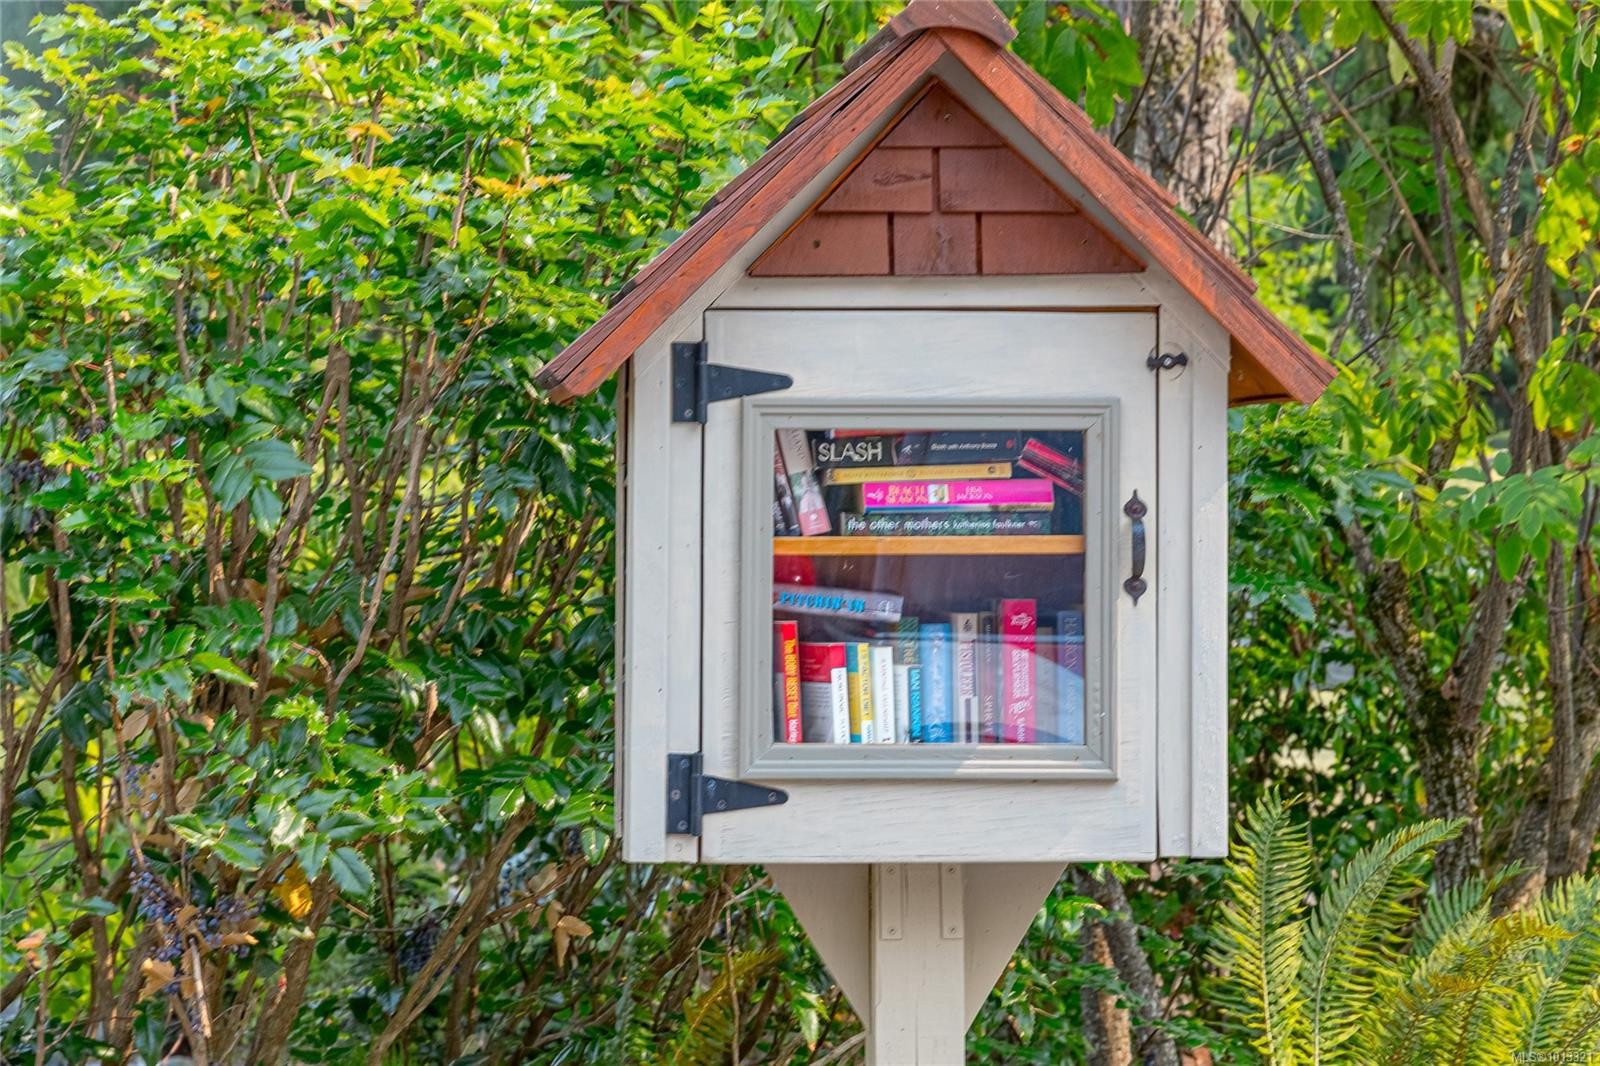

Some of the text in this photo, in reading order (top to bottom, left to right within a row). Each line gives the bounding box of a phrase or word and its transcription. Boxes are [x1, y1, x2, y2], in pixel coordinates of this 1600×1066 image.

[817, 441, 882, 461] SLASH
[847, 517, 866, 530] the
[869, 517, 900, 530] other
[903, 516, 950, 531] mothers
[911, 668, 922, 737] IAN RANKIN
